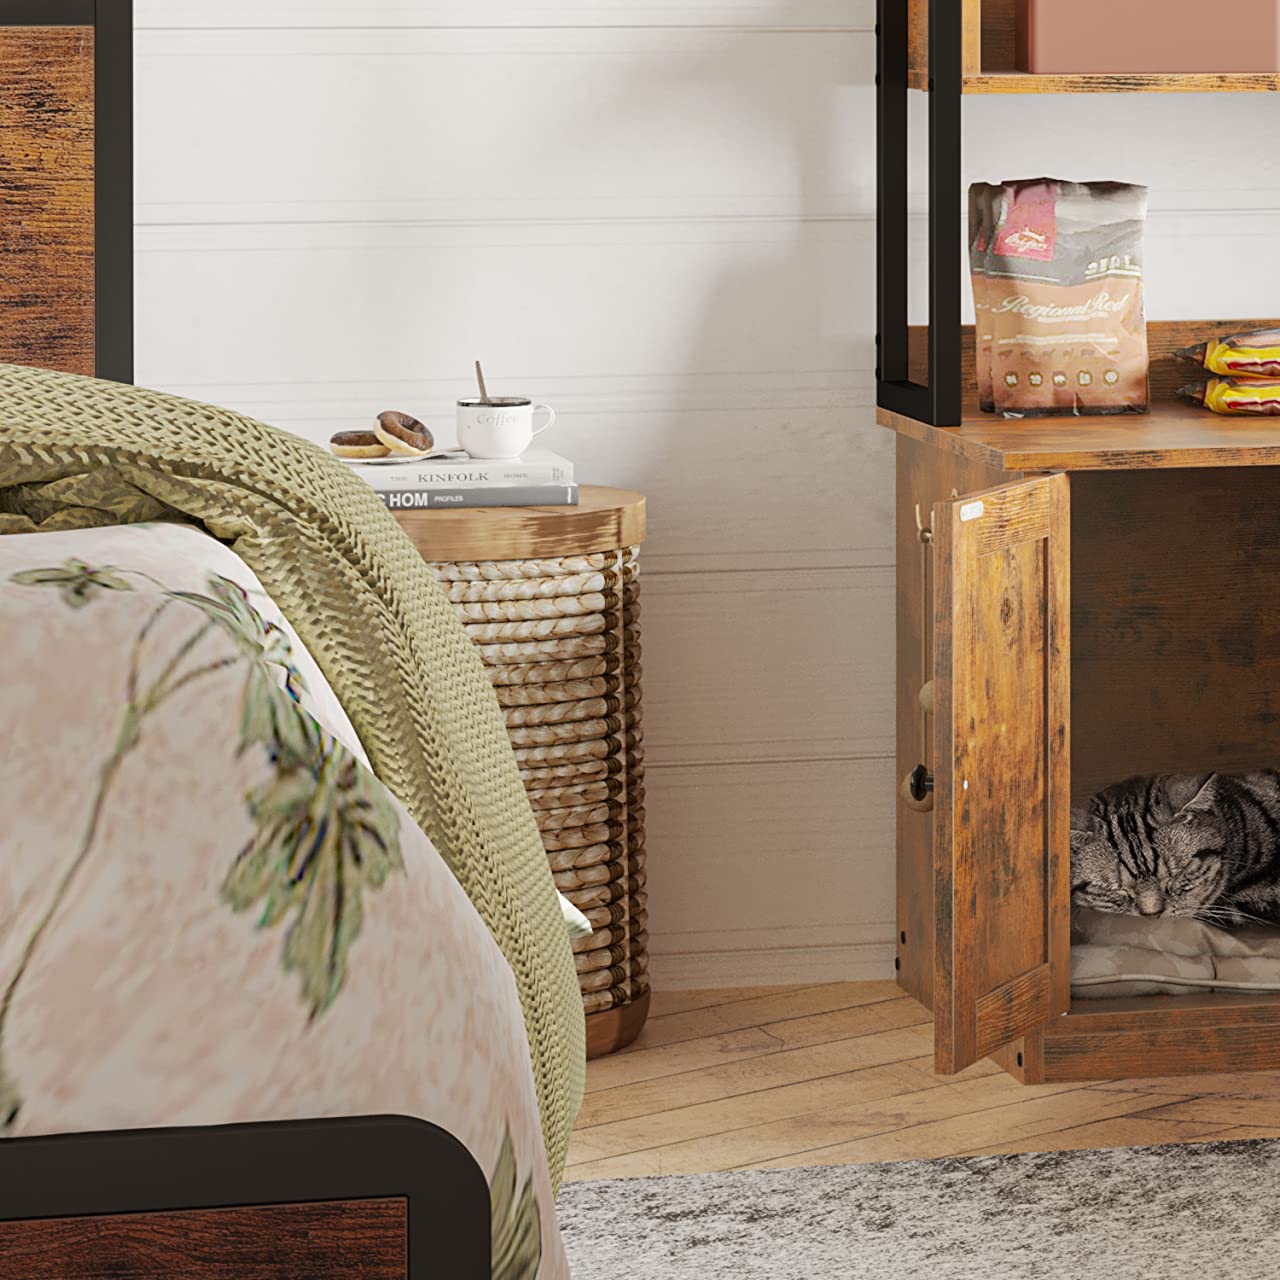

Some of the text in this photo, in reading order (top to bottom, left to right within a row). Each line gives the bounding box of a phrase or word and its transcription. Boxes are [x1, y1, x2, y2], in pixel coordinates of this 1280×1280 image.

[417, 472, 489, 483] KINFOLK
[389, 492, 428, 507] HOM
[434, 495, 464, 503] PROFILES
